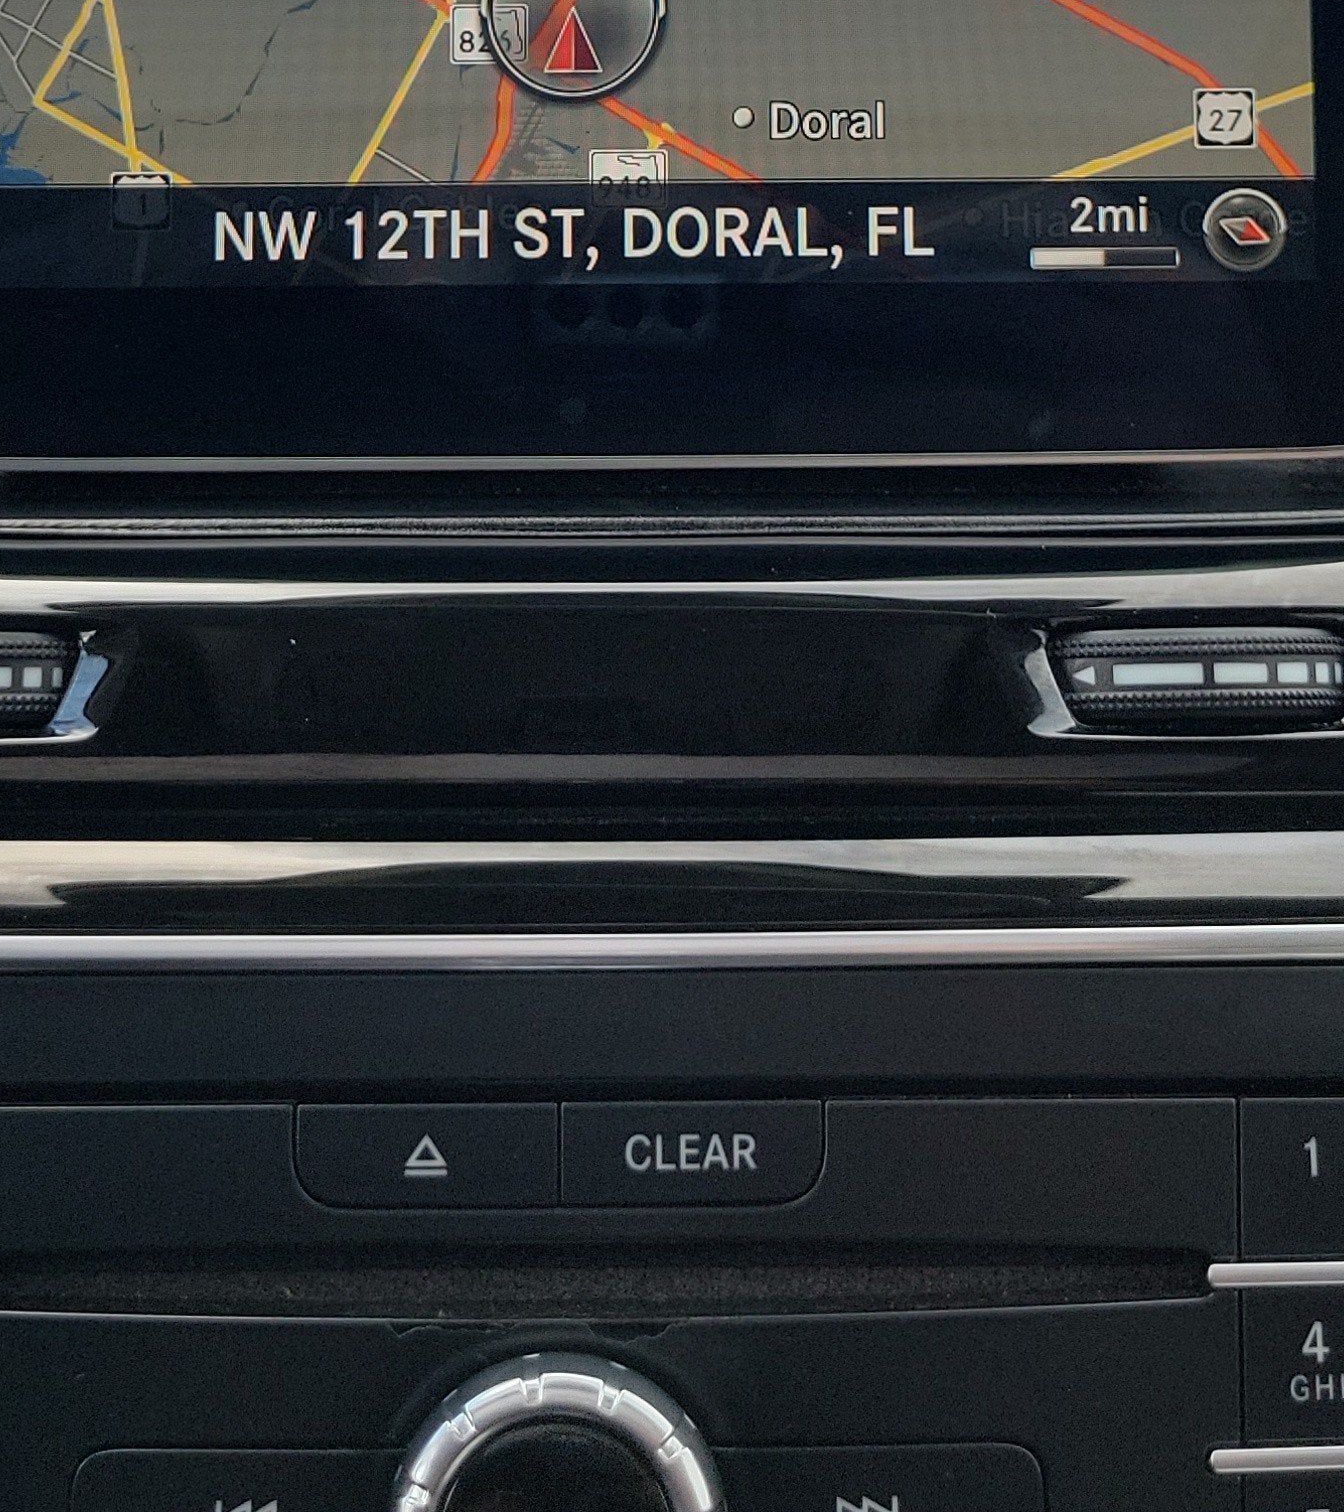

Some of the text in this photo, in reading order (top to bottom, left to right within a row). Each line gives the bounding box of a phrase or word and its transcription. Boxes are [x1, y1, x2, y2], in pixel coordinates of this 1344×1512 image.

[769, 100, 886, 141] Doral
[1208, 109, 1242, 133] 27
[1069, 196, 1148, 234] 2mi
[213, 211, 317, 261] NW
[344, 209, 488, 260] 12TH
[513, 208, 599, 270] ST,
[623, 206, 844, 268] DORAL,
[867, 205, 935, 257] FL
[625, 1133, 758, 1171] CLEAR
[1303, 1135, 1320, 1178] 1
[1301, 1321, 1329, 1363] 4
